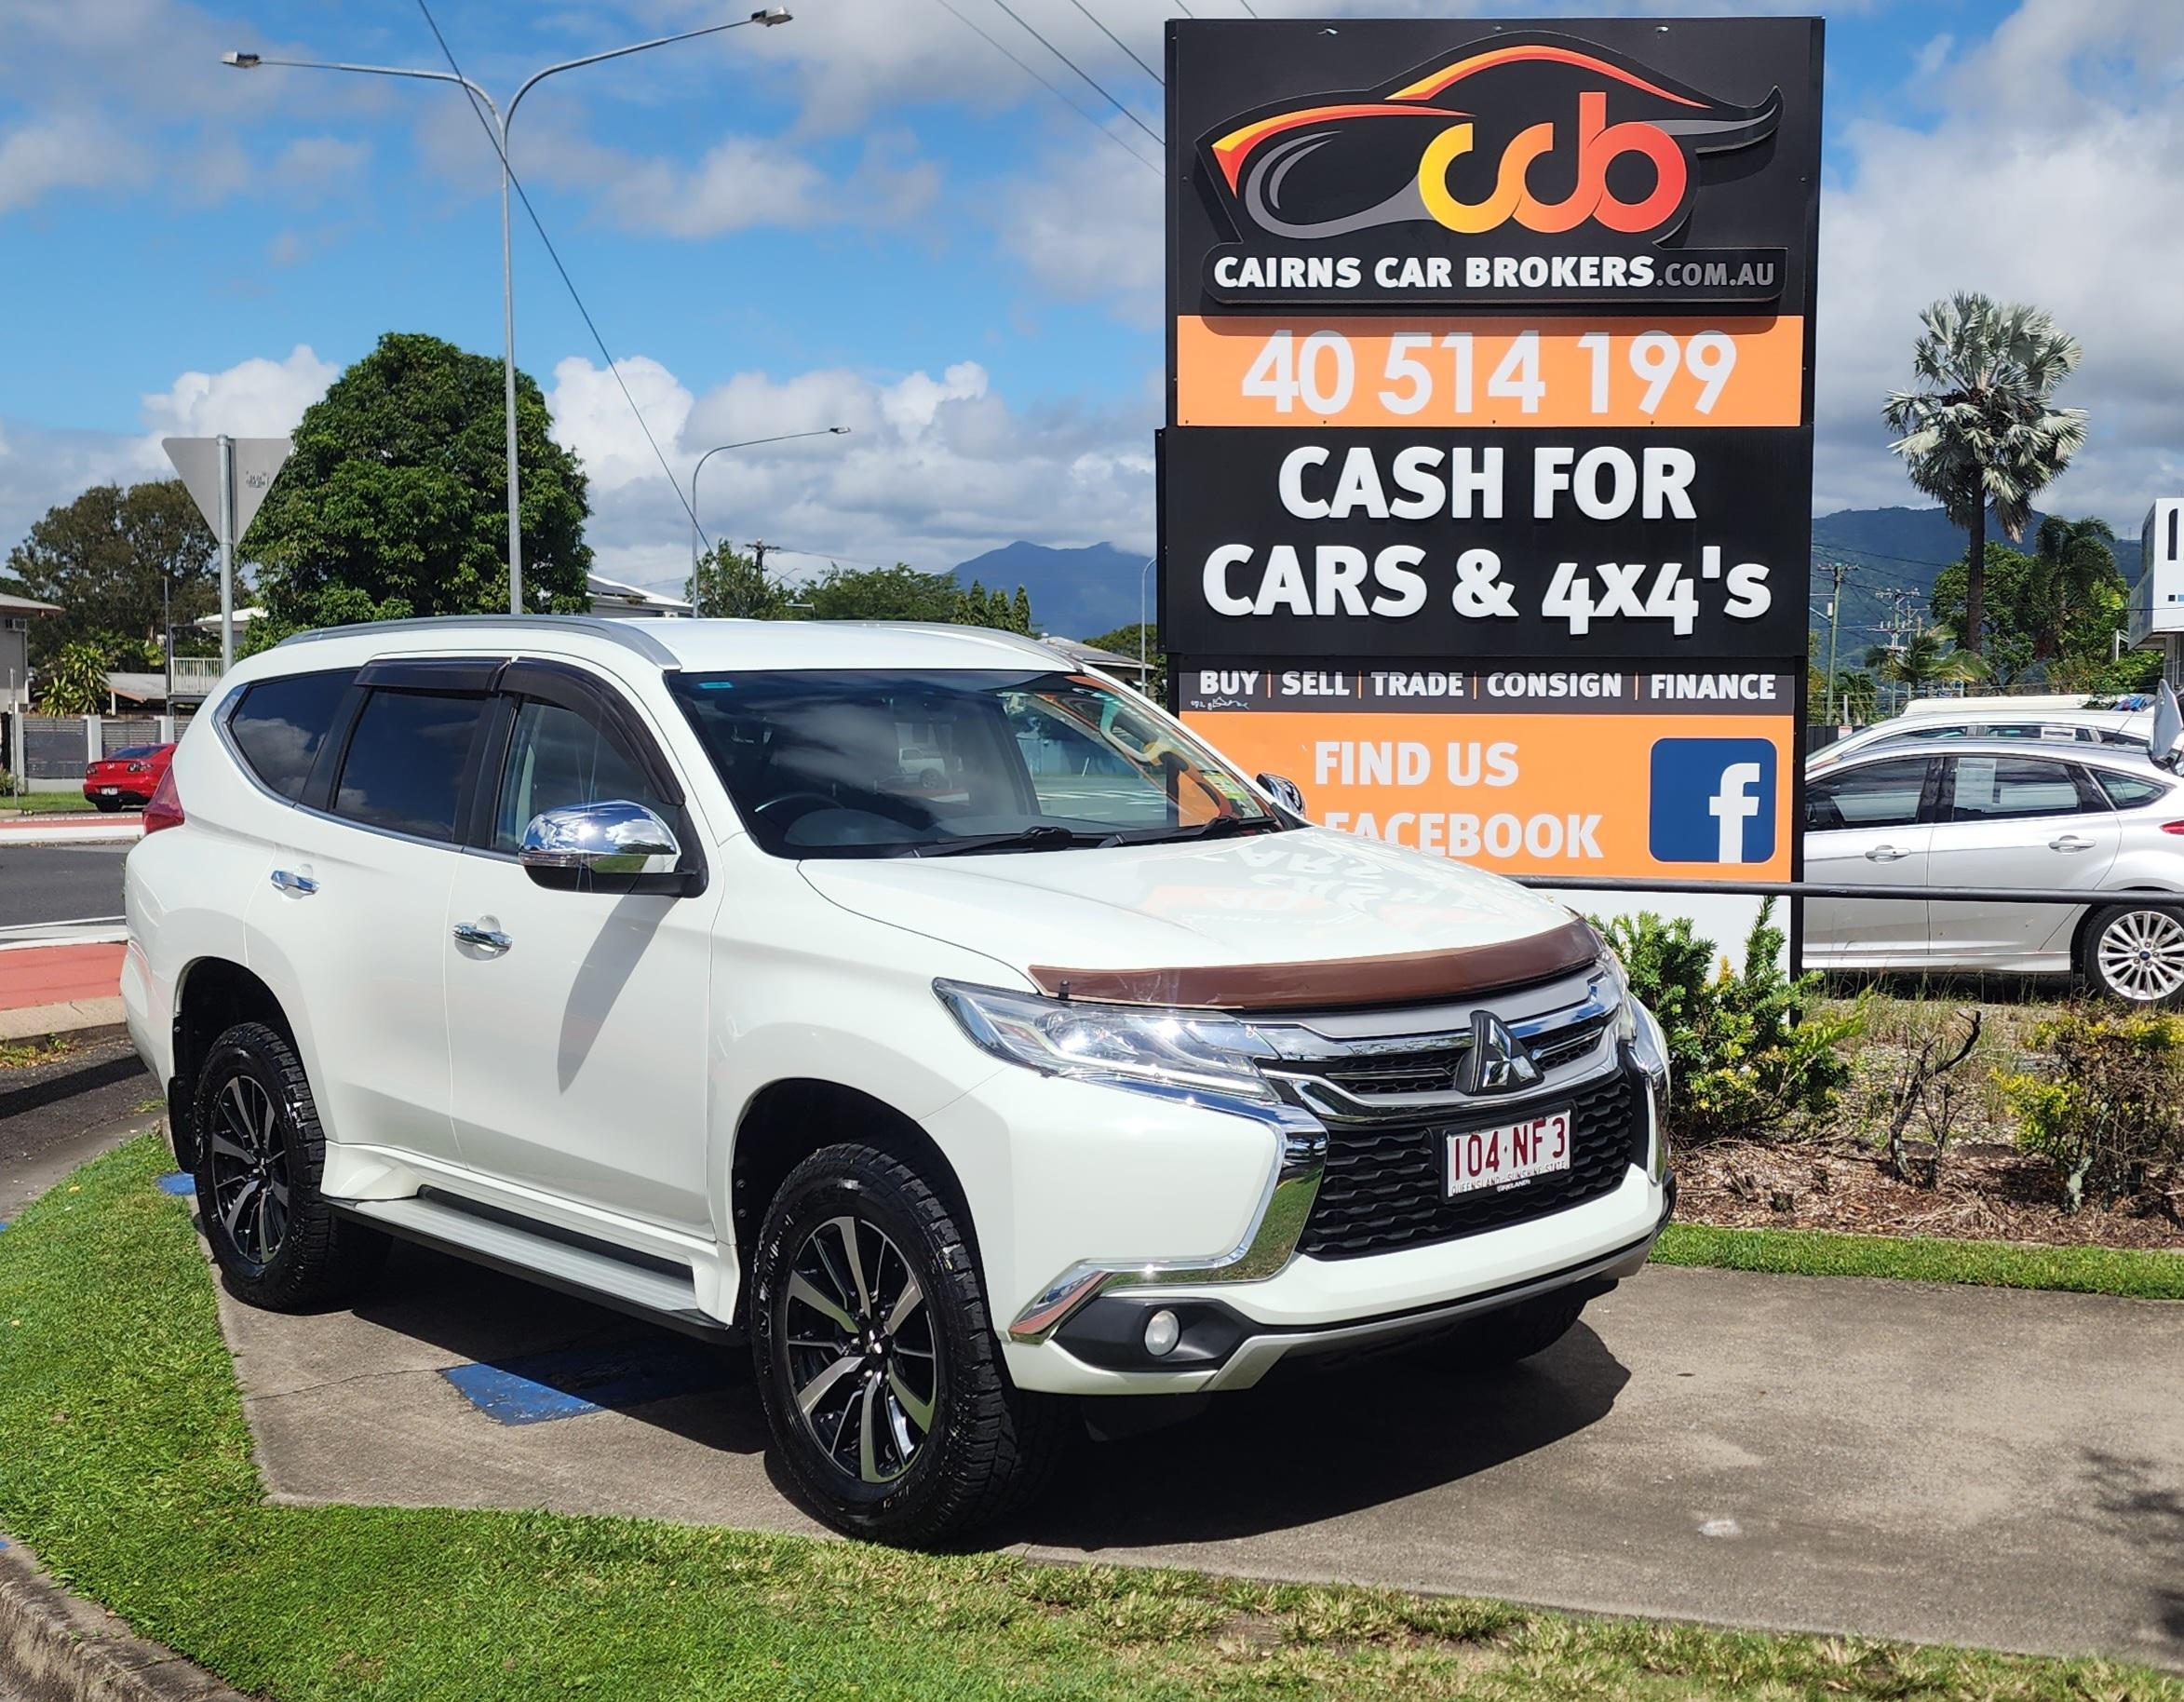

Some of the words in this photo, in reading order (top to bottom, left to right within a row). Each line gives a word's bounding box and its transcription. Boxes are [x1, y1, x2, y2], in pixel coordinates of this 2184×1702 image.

[1214, 256, 1361, 288] CAIRNS
[1374, 257, 1452, 288] CAR
[1241, 330, 1355, 414] 40
[1377, 331, 1546, 414] 514
[1577, 330, 1737, 415] 199
[1278, 446, 1504, 520] CASH
[1532, 447, 1697, 520] FOR
[1202, 544, 1427, 617] CARS
[1451, 548, 1519, 618] &
[1199, 669, 1260, 696] BUY
[1281, 670, 1350, 697] SELL
[1370, 671, 1464, 697] TRADE
[1486, 672, 1623, 699] CONSIGN
[1650, 674, 1776, 700] FINANCE
[1314, 740, 1431, 786] FIND
[1447, 742, 1519, 787] US
